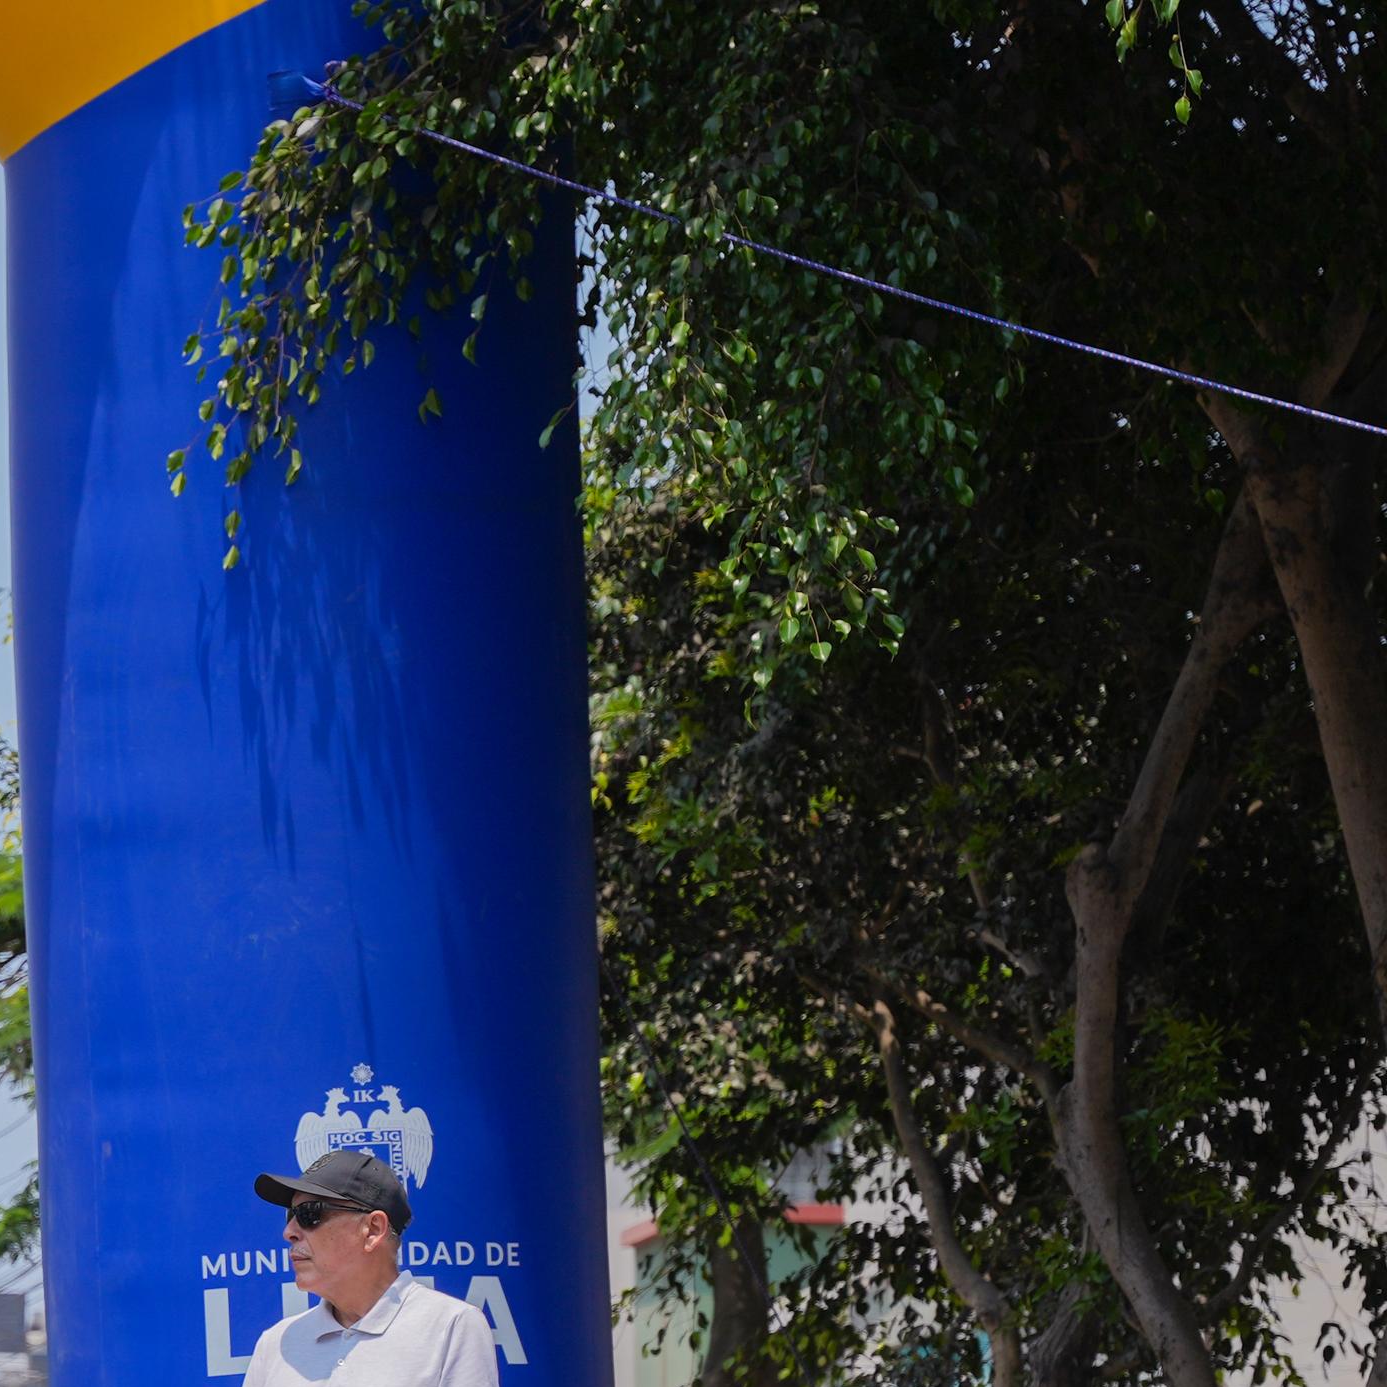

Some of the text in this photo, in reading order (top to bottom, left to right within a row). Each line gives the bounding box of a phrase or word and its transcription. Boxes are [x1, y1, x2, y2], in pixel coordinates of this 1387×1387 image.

[353, 1089, 375, 1103] IK
[329, 1132, 367, 1144] HOC
[486, 1242, 520, 1267] DE
